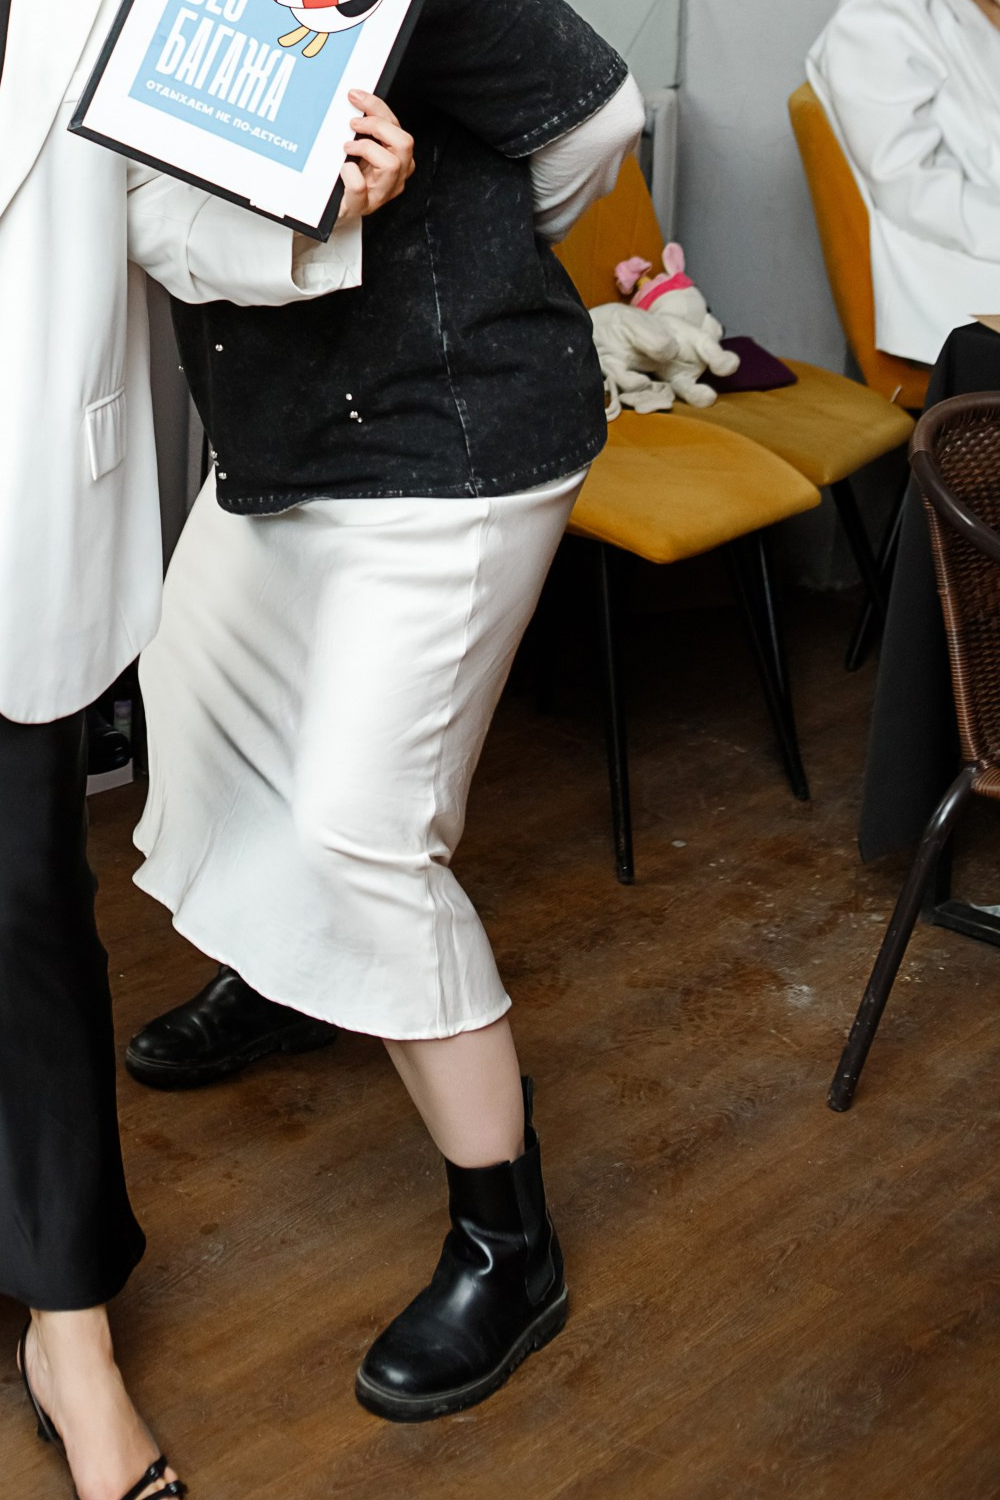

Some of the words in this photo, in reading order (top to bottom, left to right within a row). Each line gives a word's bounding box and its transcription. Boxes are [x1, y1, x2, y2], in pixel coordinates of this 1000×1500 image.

[156, 7, 297, 122] БАГАЖА
[146, 79, 214, 117] ОТДЫХАЕМ
[215, 109, 232, 124] НЕ
[232, 117, 299, 153] ПО-ДЕТСКИ
